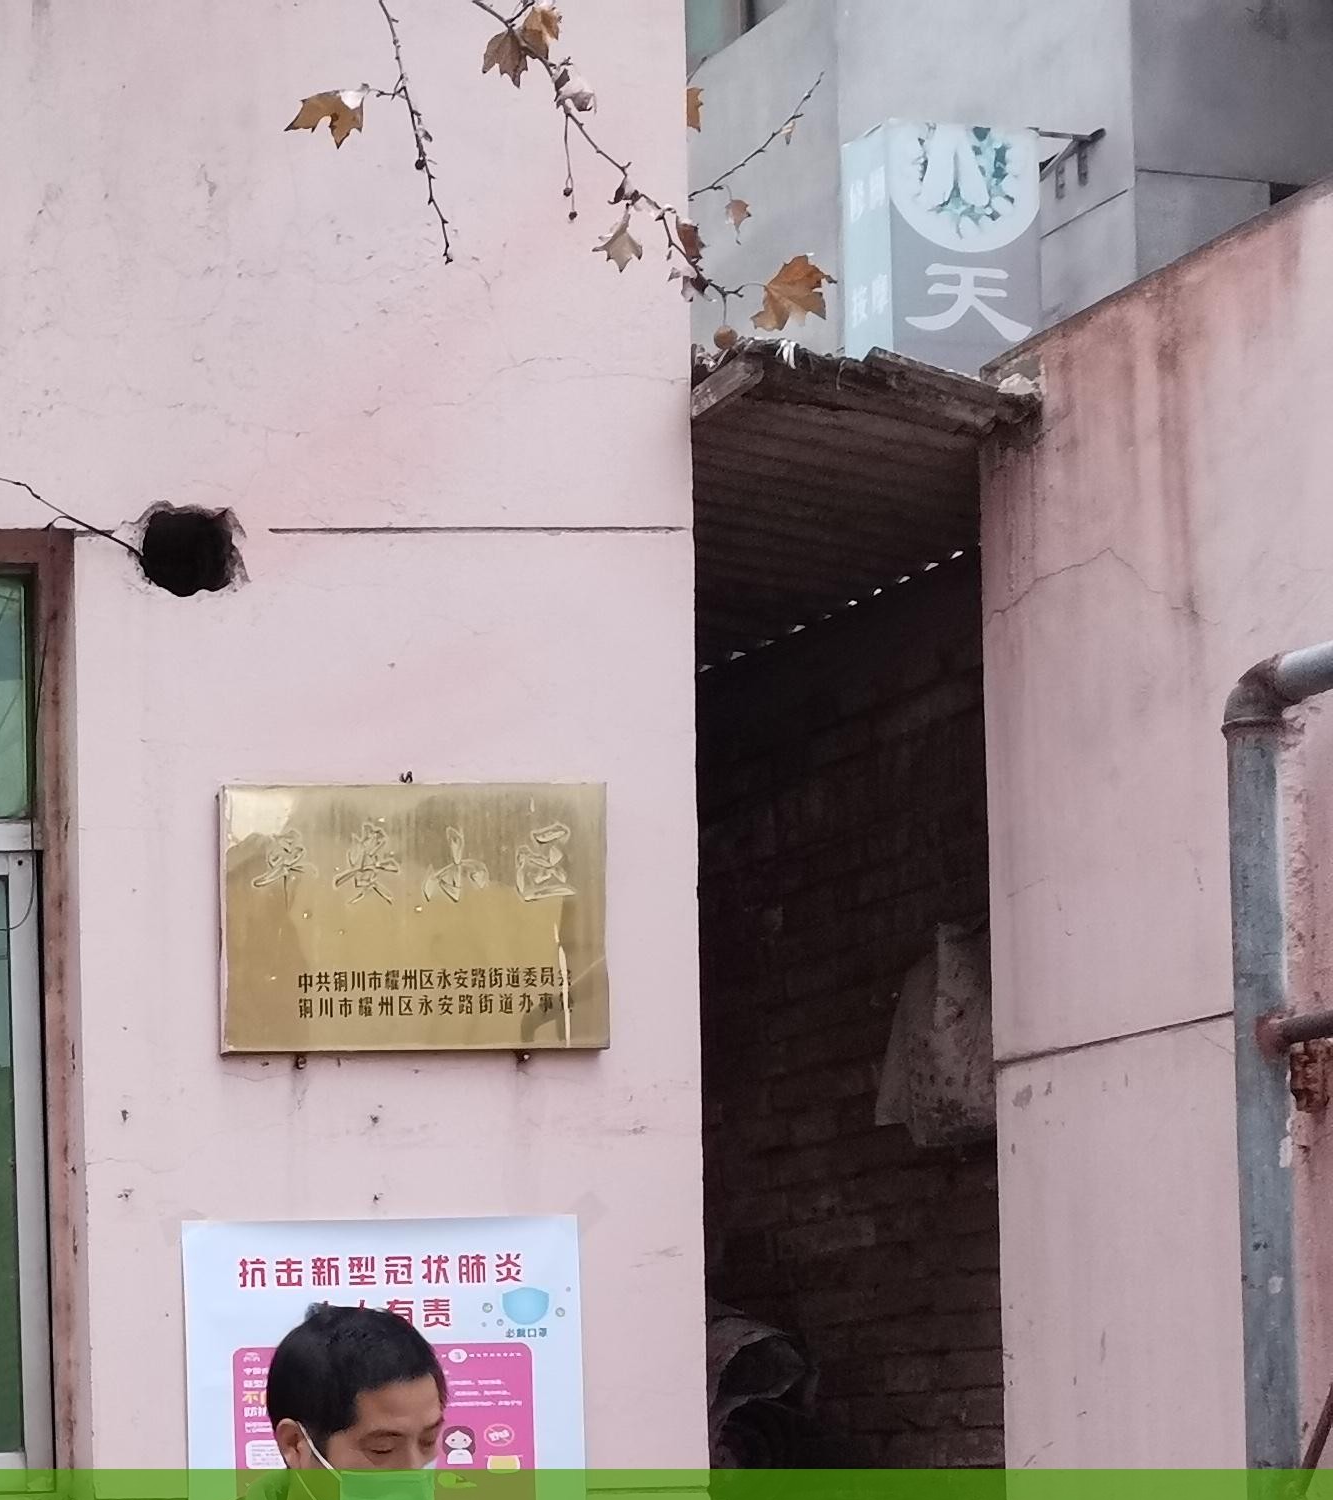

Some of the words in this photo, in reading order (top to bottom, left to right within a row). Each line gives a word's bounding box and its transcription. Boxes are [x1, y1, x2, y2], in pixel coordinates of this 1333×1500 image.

[905, 263, 1032, 342] 天
[238, 1253, 523, 1288] 抗击新型冠状肺炎
